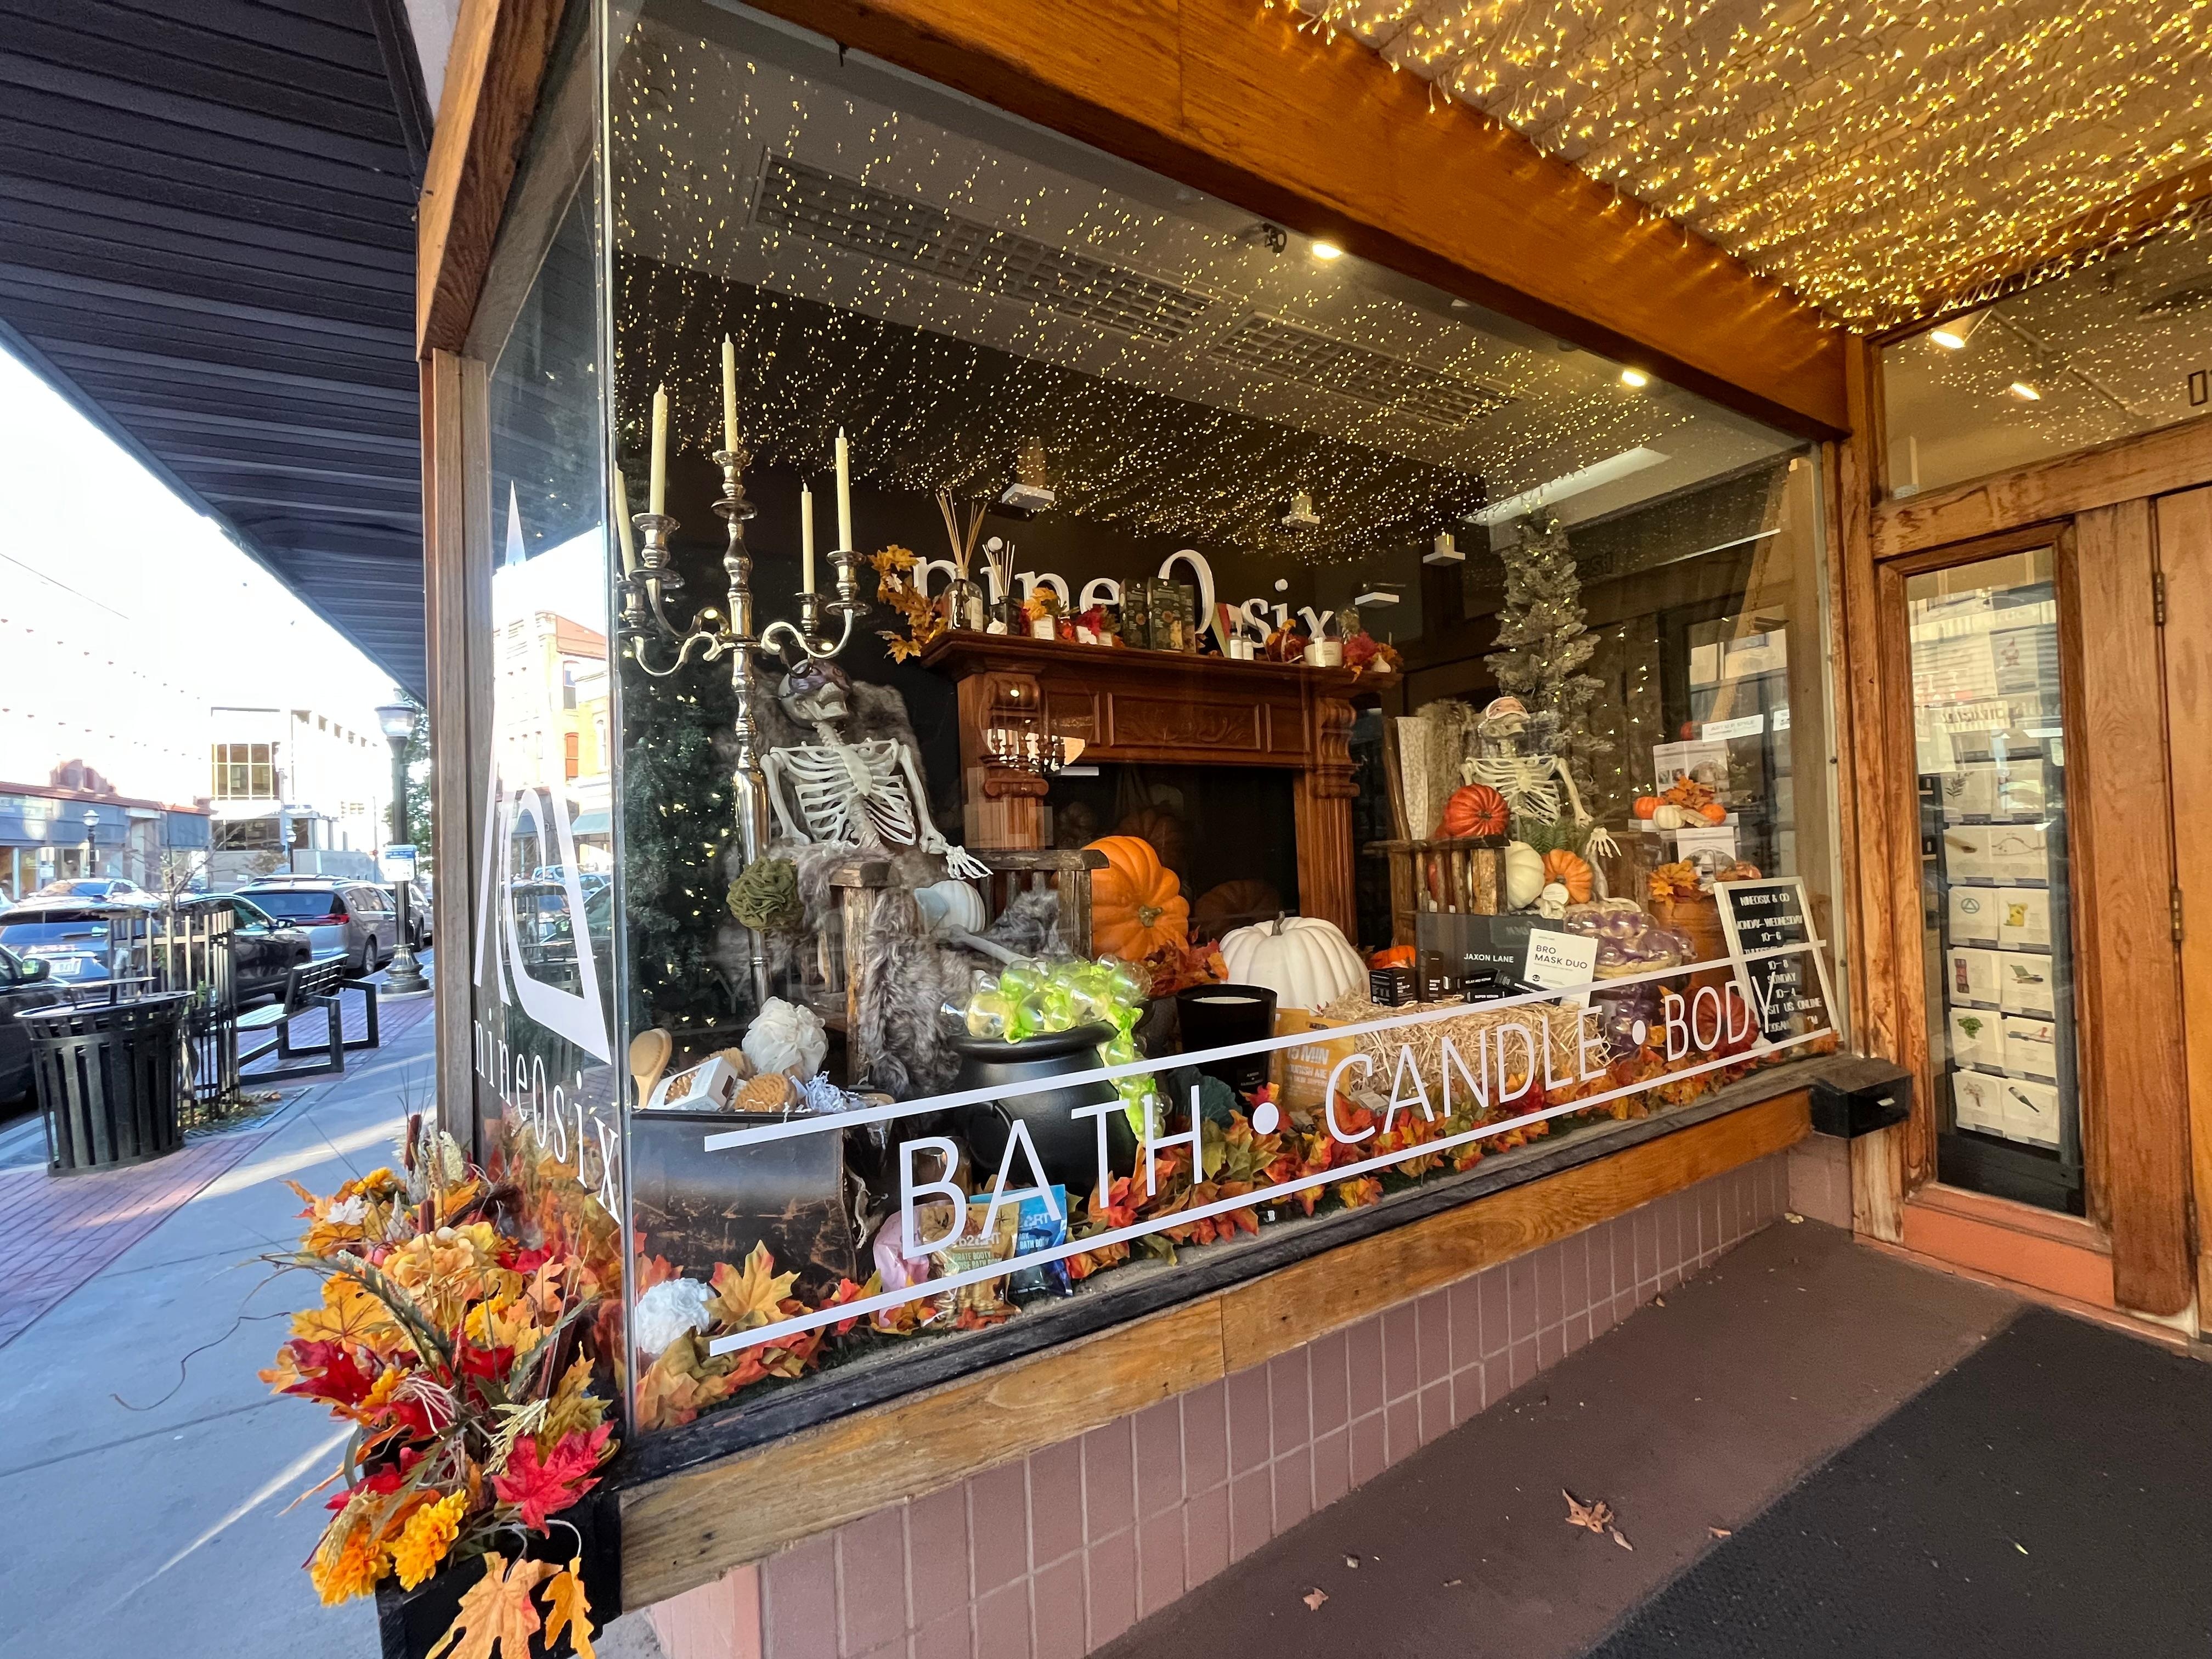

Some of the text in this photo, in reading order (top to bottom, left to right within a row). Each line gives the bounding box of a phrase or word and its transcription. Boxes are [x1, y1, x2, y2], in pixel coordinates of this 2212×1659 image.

[1536, 945, 1556, 954] BRO
[1463, 952, 1514, 963] JAXON LANE
[1534, 953, 1563, 965] MASK
[1566, 959, 1588, 969] DUO
[1783, 1001, 1795, 1012] US
[1301, 1045, 1330, 1065] MIN
[900, 972, 1776, 1260] BATH CANDLE BODY
[1019, 1239, 1035, 1250] BATH
[973, 1251, 992, 1261] BOOTY
